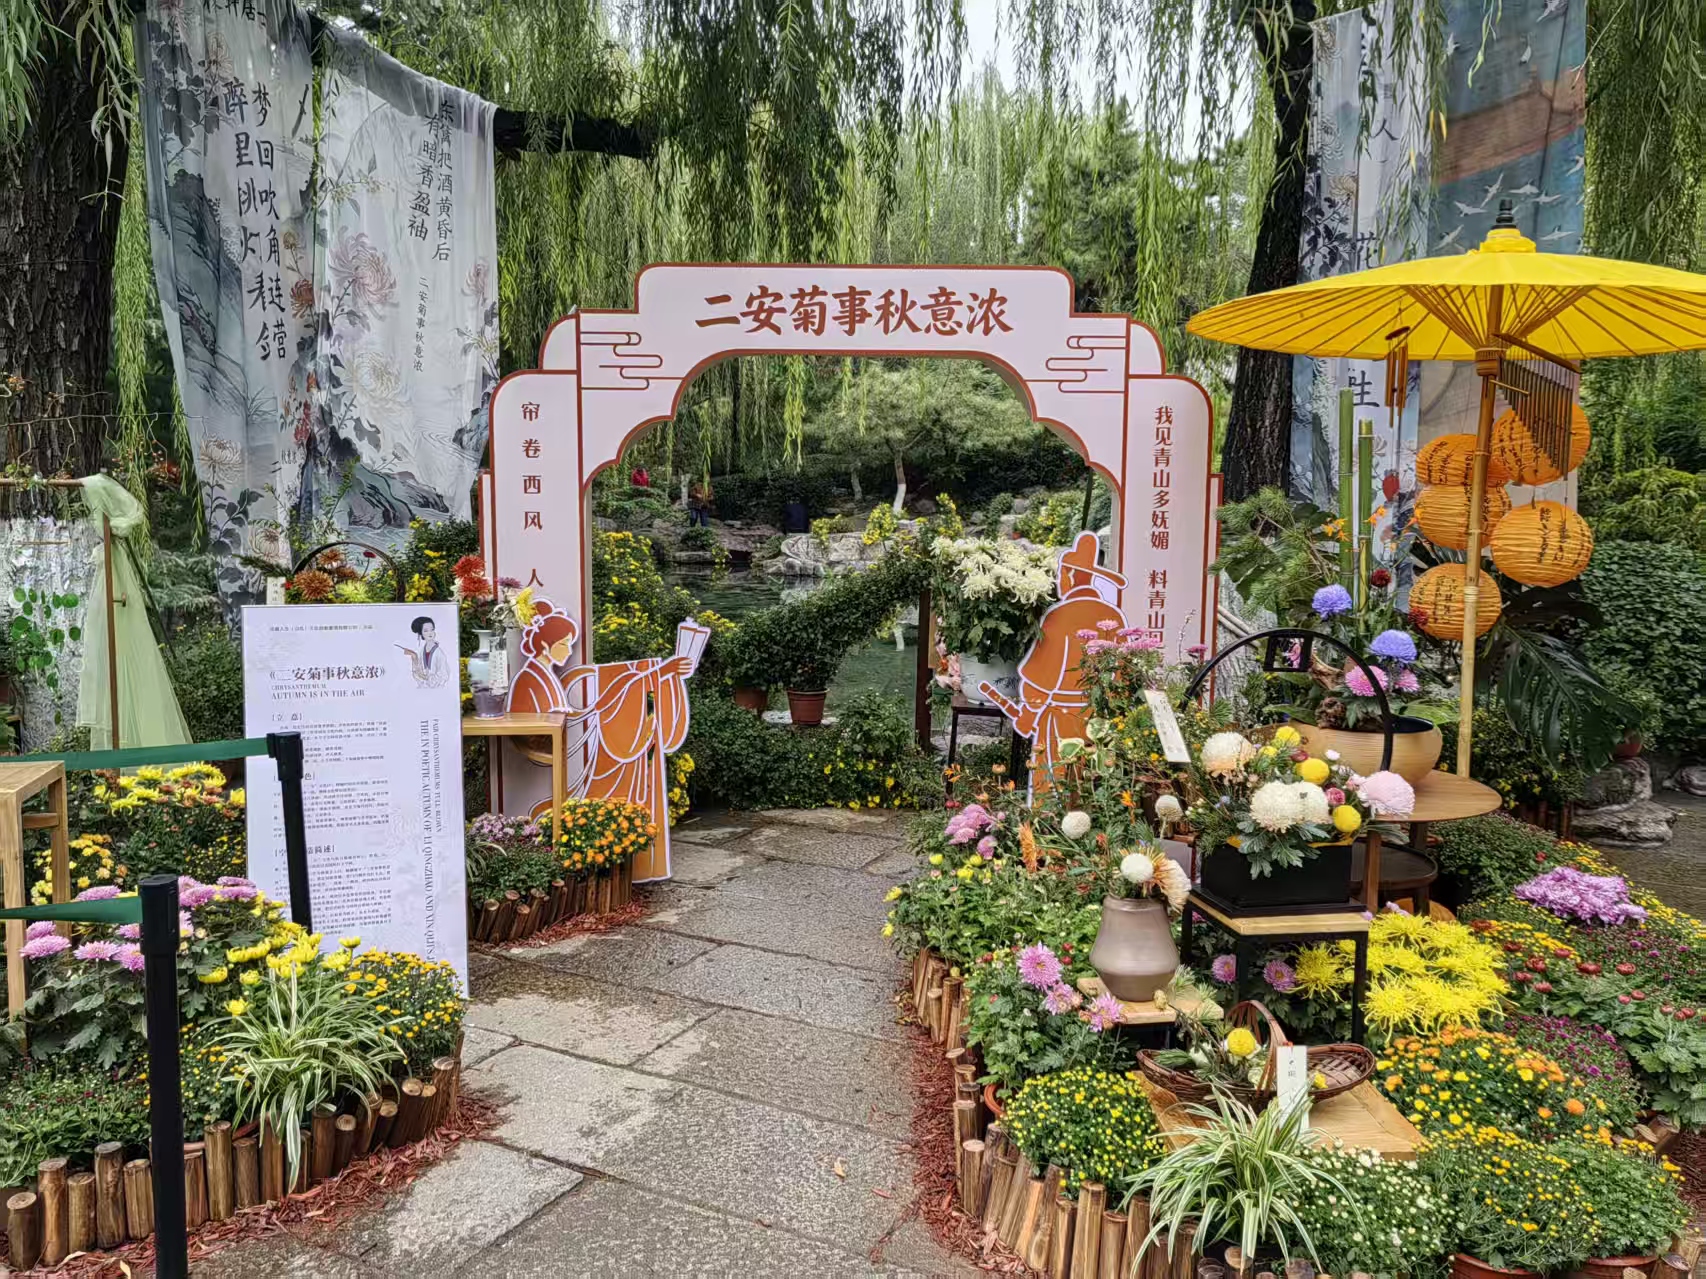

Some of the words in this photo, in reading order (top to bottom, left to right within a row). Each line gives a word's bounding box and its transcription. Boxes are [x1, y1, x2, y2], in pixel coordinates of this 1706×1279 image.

[407, 113, 439, 241] 有暗香盈袖
[413, 276, 429, 372] 二安菊事秋意浓
[695, 285, 1014, 336] 二安菊事秋意浓
[521, 401, 543, 531] 帘卷西风
[1150, 406, 1174, 550] 我见青山多妩媚
[271, 690, 308, 700] AUTUMN
[309, 690, 318, 699] IS
[320, 690, 330, 698] IN
[332, 689, 349, 698] THE
[350, 688, 365, 697] AIR
[420, 720, 429, 737] THE
[421, 738, 429, 748] IN
[421, 749, 430, 781] POETIC
[422, 783, 432, 818] AUTUMN
[423, 820, 432, 832] OF
[422, 846, 433, 892] QINGZHAO
[425, 893, 433, 912] AND
[425, 913, 434, 929] XIN
